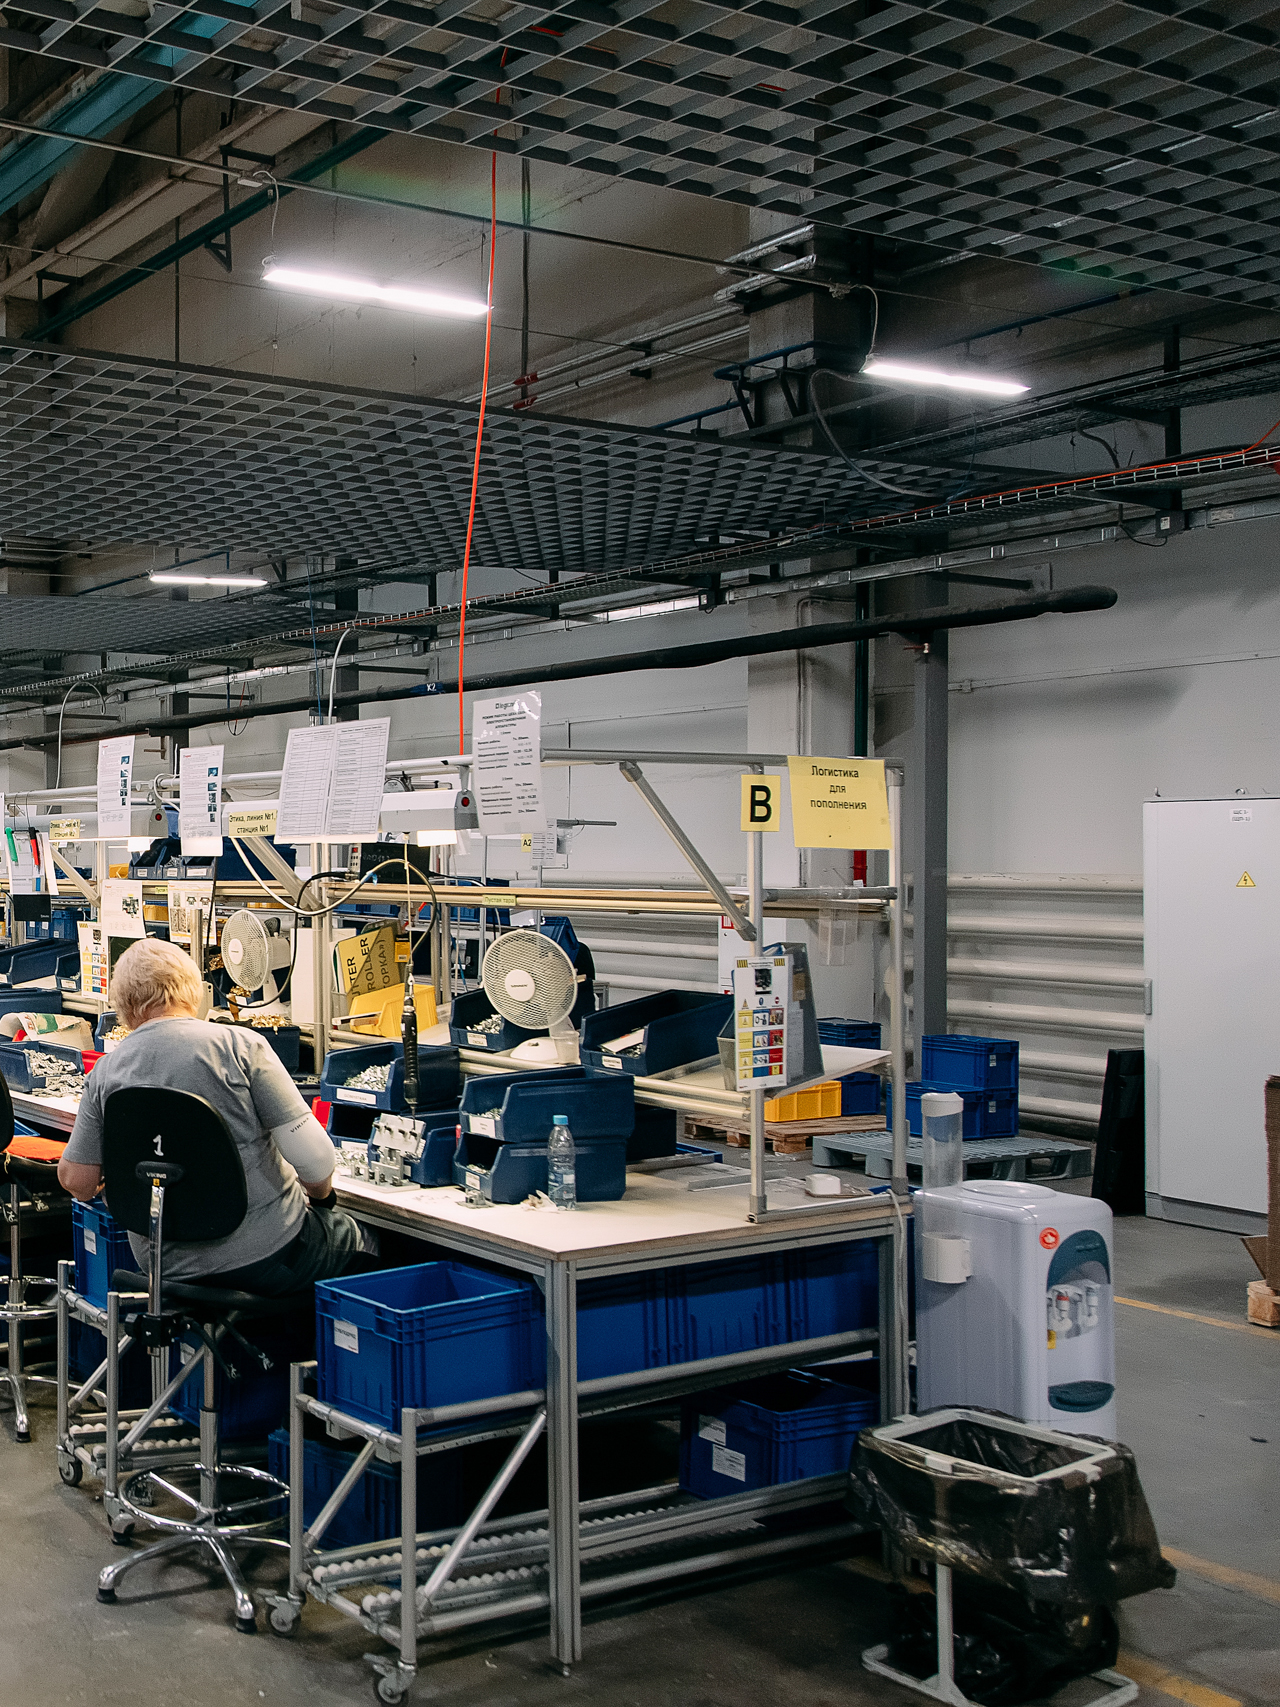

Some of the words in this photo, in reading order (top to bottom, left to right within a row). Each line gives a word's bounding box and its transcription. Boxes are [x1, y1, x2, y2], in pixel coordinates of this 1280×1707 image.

[811, 765, 860, 779] Логистика
[829, 783, 846, 795] для
[810, 798, 868, 811] пополнения
[152, 1134, 164, 1156] 1
[146, 1171, 167, 1179] VIKING
